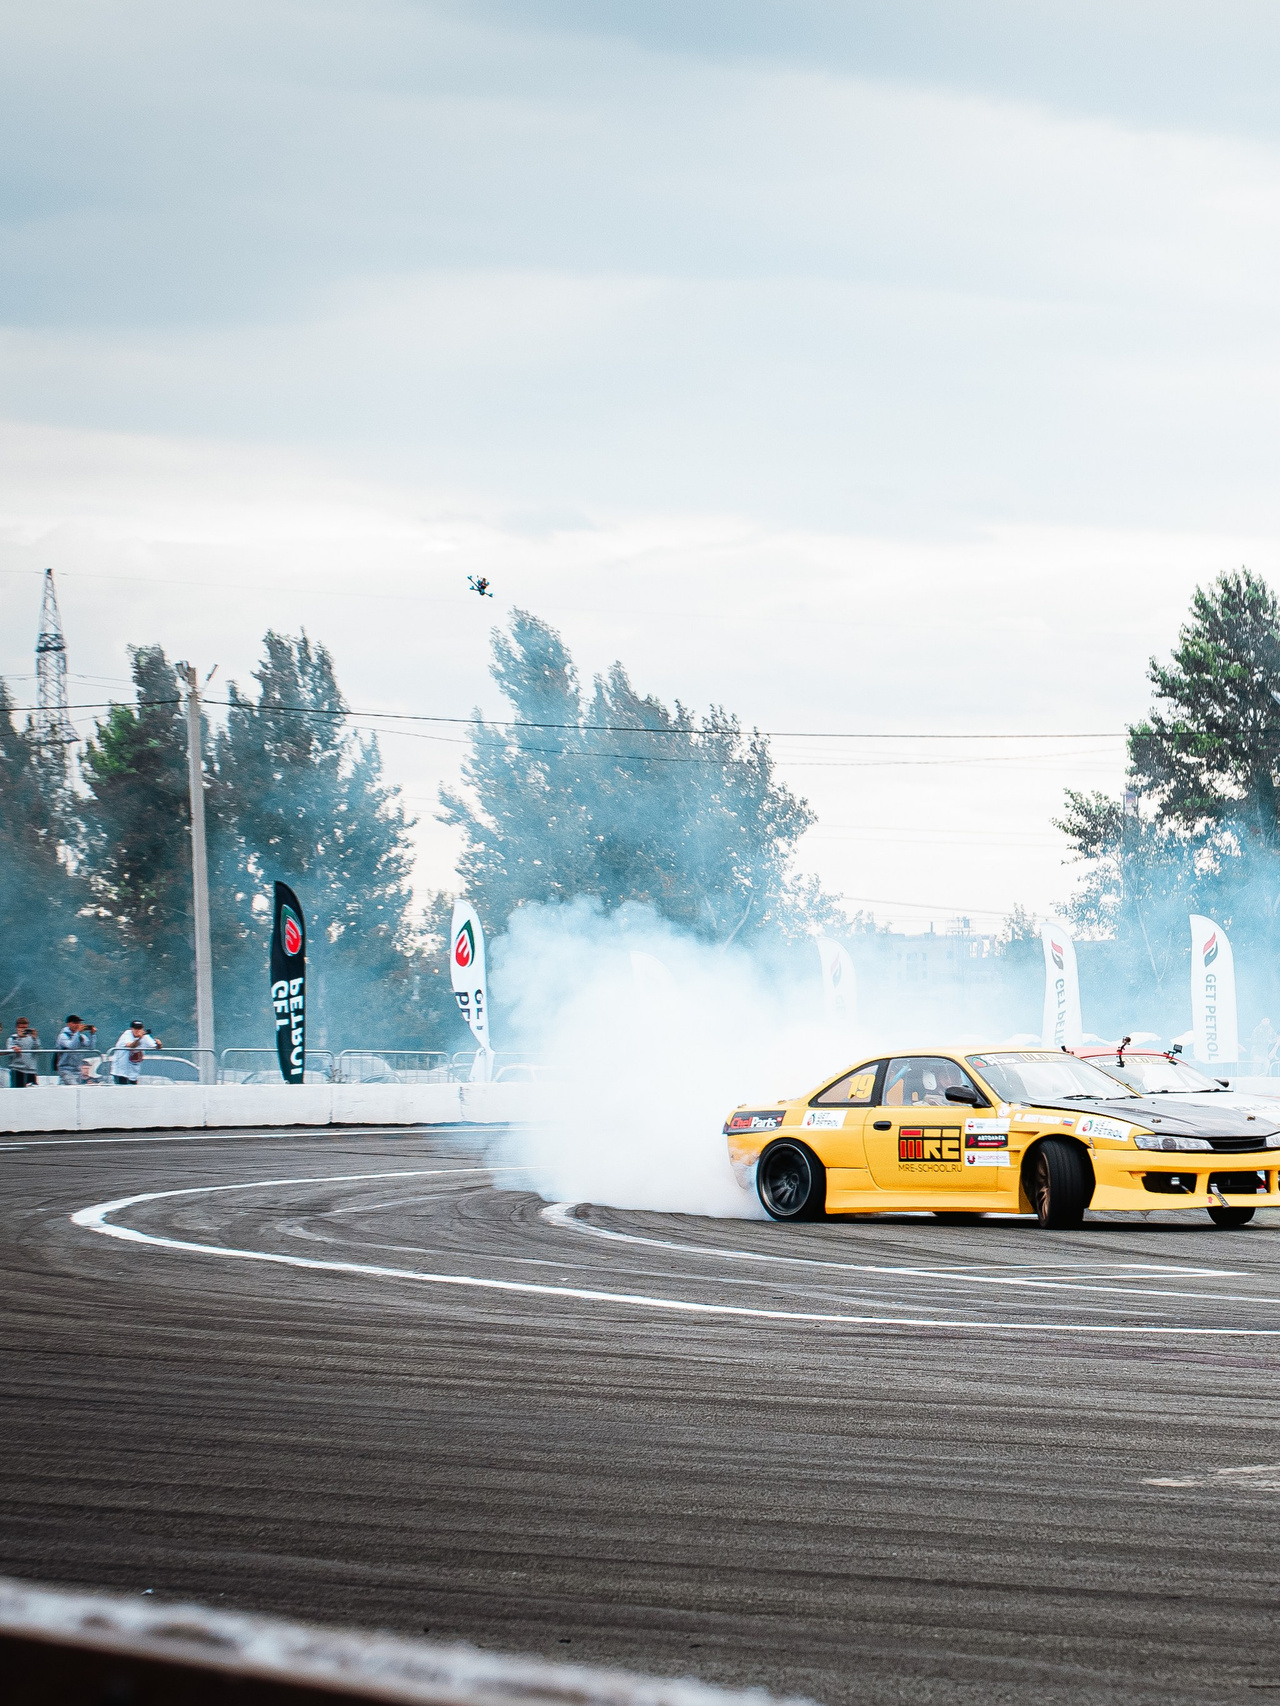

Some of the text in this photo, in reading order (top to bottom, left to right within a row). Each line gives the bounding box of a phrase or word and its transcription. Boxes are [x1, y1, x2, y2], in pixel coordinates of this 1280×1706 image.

[1205, 973, 1219, 1061] GET PETROL
[1021, 1053, 1050, 1061] ULD
[848, 1074, 876, 1099] 19
[731, 1116, 777, 1129] ChelParts
[1092, 1126, 1123, 1138] PETROL
[898, 1163, 962, 1173] MRE-SCHOOL.RU
